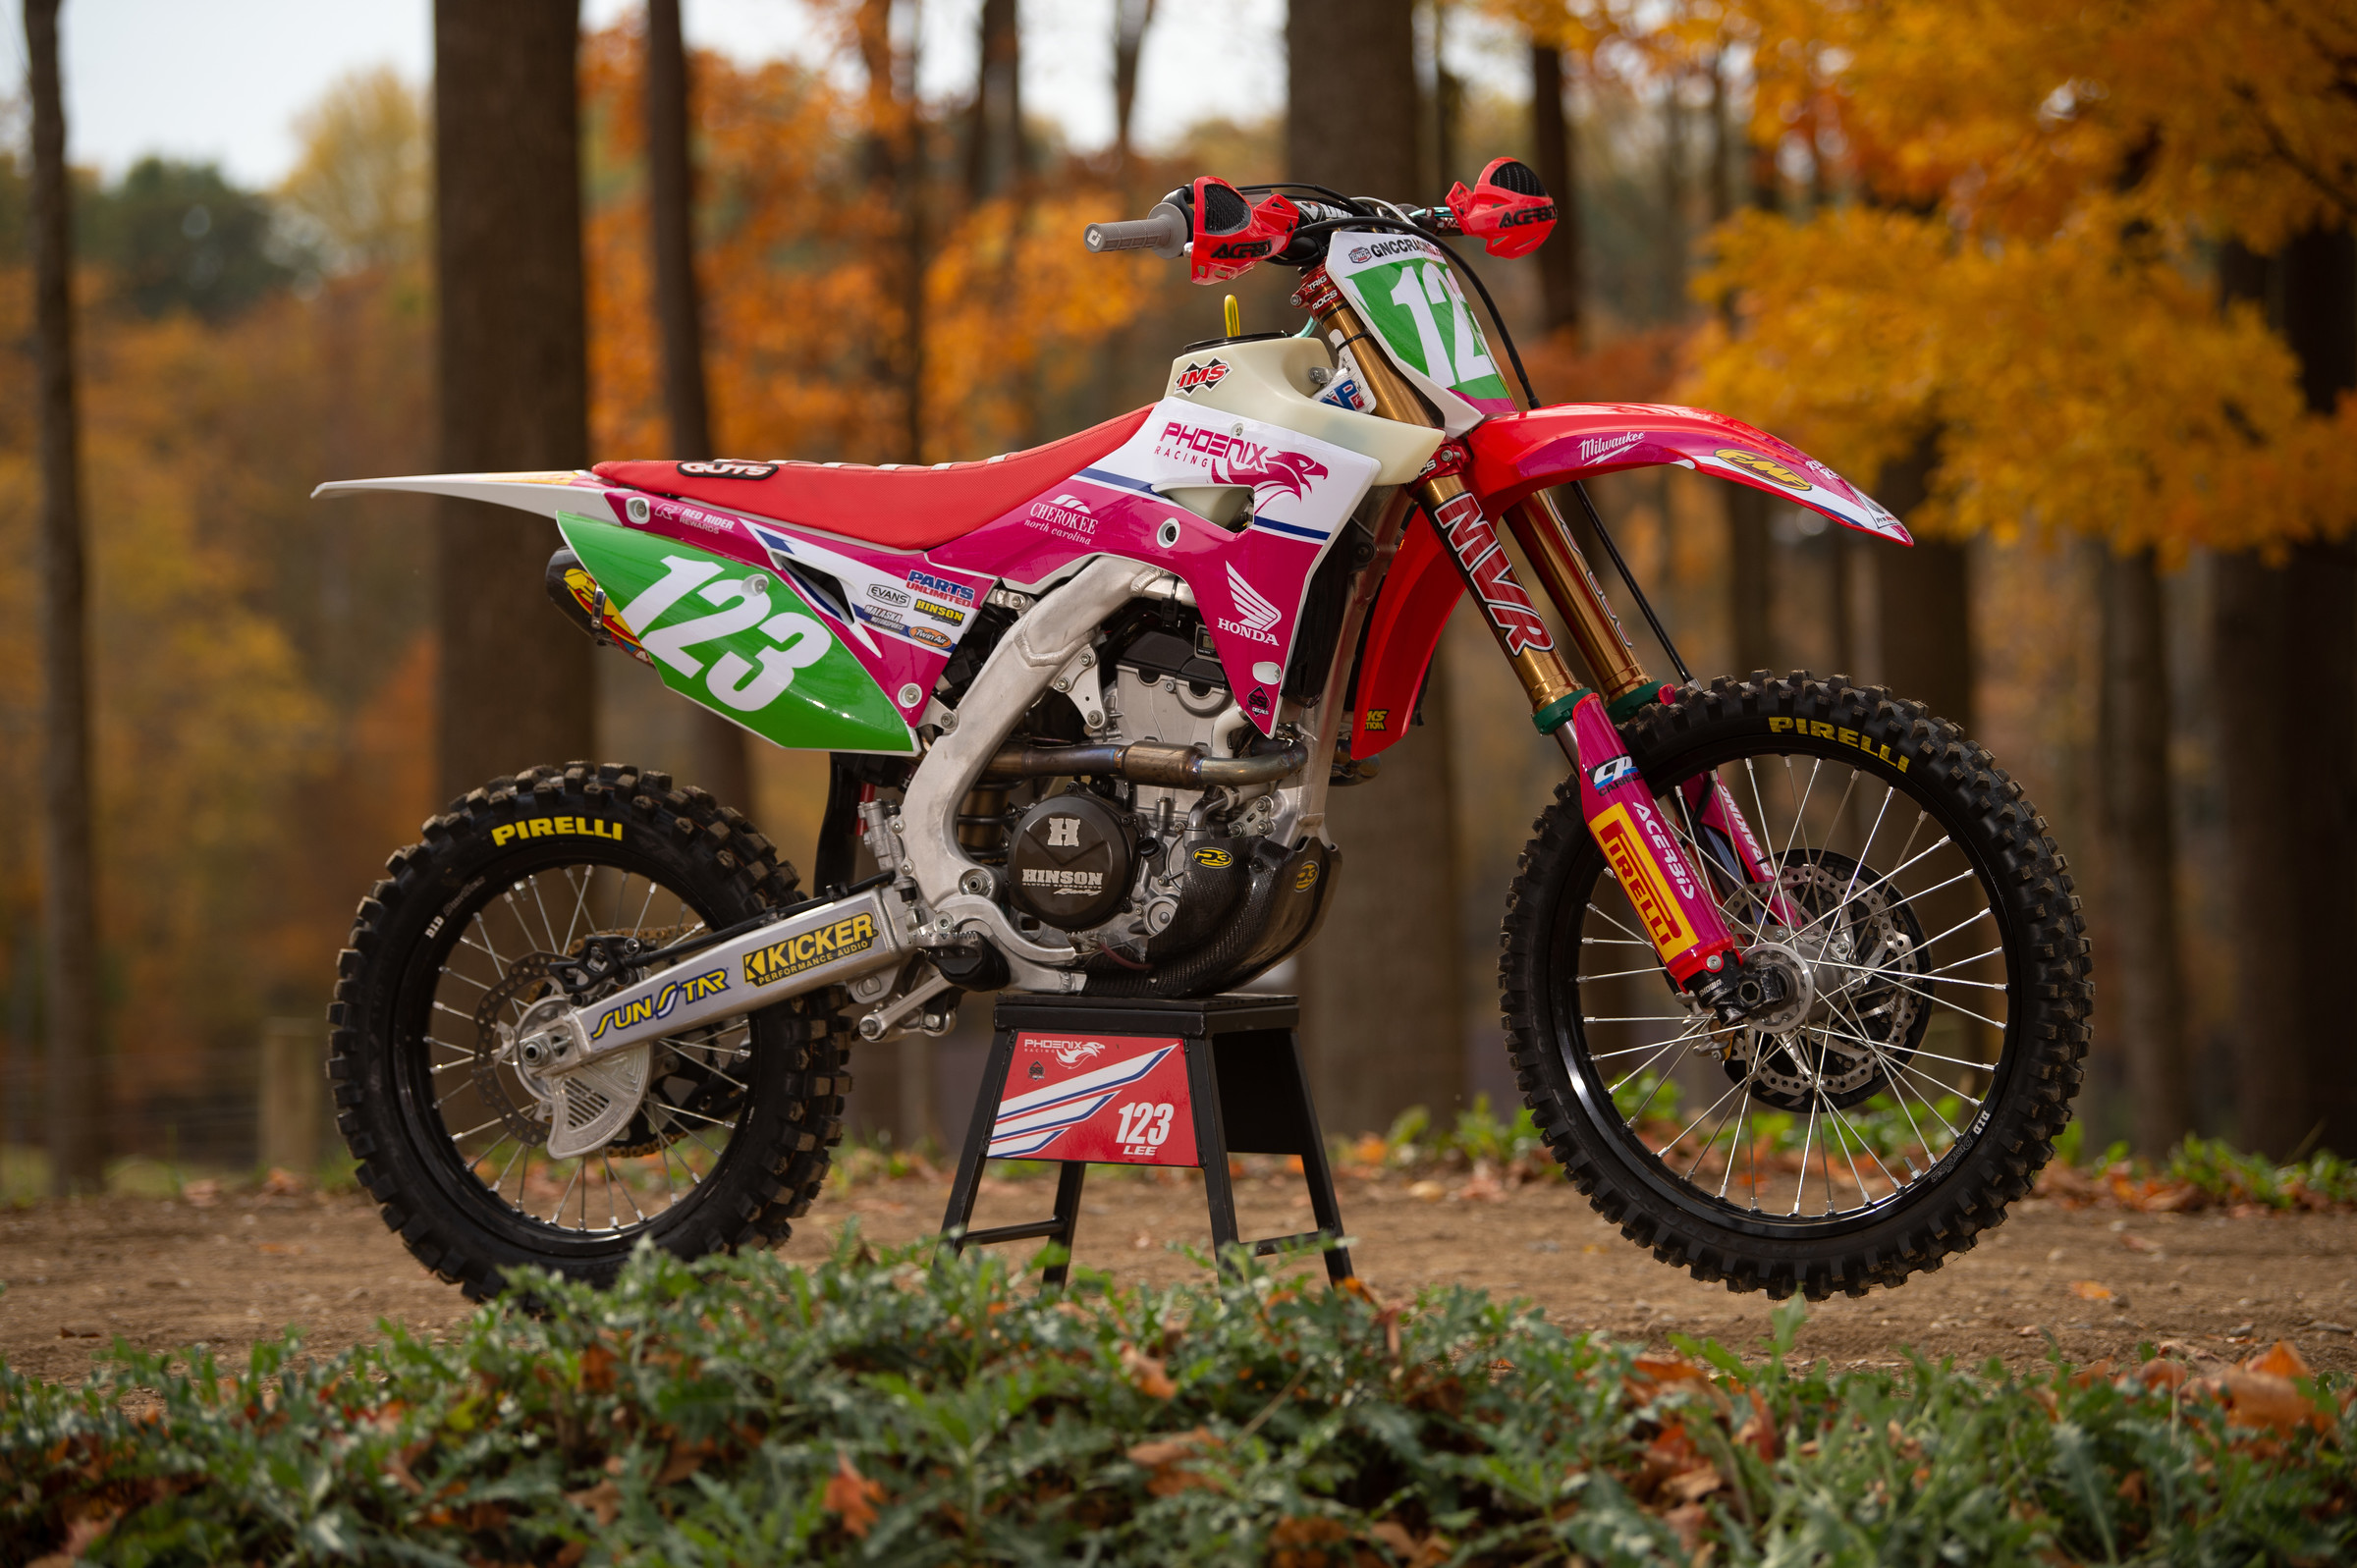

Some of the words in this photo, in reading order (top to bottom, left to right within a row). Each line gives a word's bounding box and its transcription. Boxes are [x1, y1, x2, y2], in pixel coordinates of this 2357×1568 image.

[1311, 289, 1338, 310] ROCS
[1390, 262, 1499, 388] 12
[1178, 363, 1227, 388] IMS
[1154, 445, 1208, 467] RACING
[1160, 421, 1269, 469] PHOENIX
[1577, 431, 1645, 460] Milwaukee
[681, 461, 772, 476] GUTS
[679, 515, 720, 535] REWARDS
[682, 508, 702, 520] RED
[703, 513, 736, 530] RIDER
[1023, 518, 1050, 533] north
[1051, 527, 1092, 546] carolina
[1029, 502, 1099, 535] CHEROKEE
[907, 568, 975, 600] PARTS
[1434, 492, 1555, 656] MVR
[870, 585, 907, 604] EVANS
[905, 581, 972, 608] UNLIMITED
[864, 604, 903, 622] MALASKA
[915, 599, 964, 622] HINSON
[620, 554, 833, 712] 123
[914, 628, 937, 641] Twin
[934, 634, 948, 645] Air
[1218, 617, 1281, 646] HONDA
[1768, 716, 1910, 774] PIRELLI
[492, 816, 623, 846] PIRELLI
[1047, 817, 1080, 846] H
[1717, 784, 1775, 878] BRAKING
[1022, 869, 1103, 886] HINSON
[1599, 818, 1682, 946] PIRELLI
[768, 914, 874, 971] KICKER
[758, 952, 834, 985] PERFORMANCE
[837, 940, 869, 957] AUDIO
[1699, 978, 1722, 998] SHOWA
[1024, 1039, 1083, 1050] PHOENIX
[1116, 1102, 1175, 1146] 123
[1123, 1145, 1158, 1157] LEE
